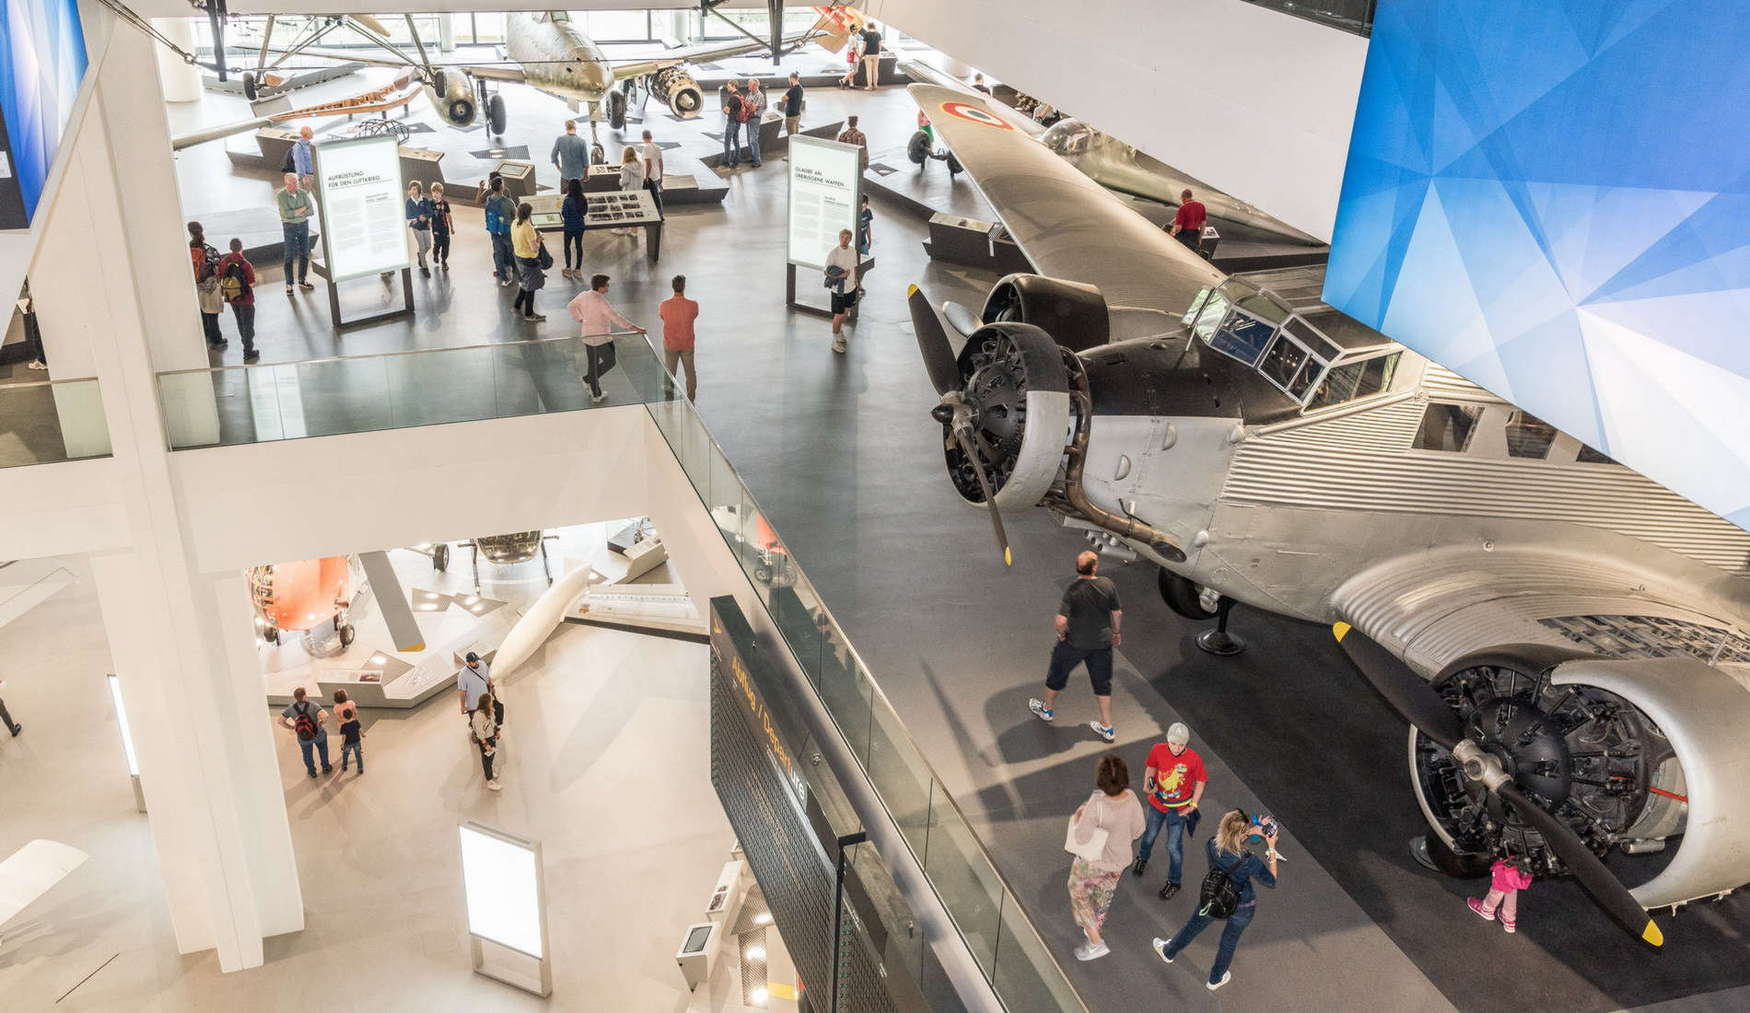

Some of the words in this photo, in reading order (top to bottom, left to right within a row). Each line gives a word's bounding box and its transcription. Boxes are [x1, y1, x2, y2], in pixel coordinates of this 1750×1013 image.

[825, 178, 845, 187] WAFFEN
[732, 655, 756, 712] Abflug
[763, 711, 805, 800] Departure
